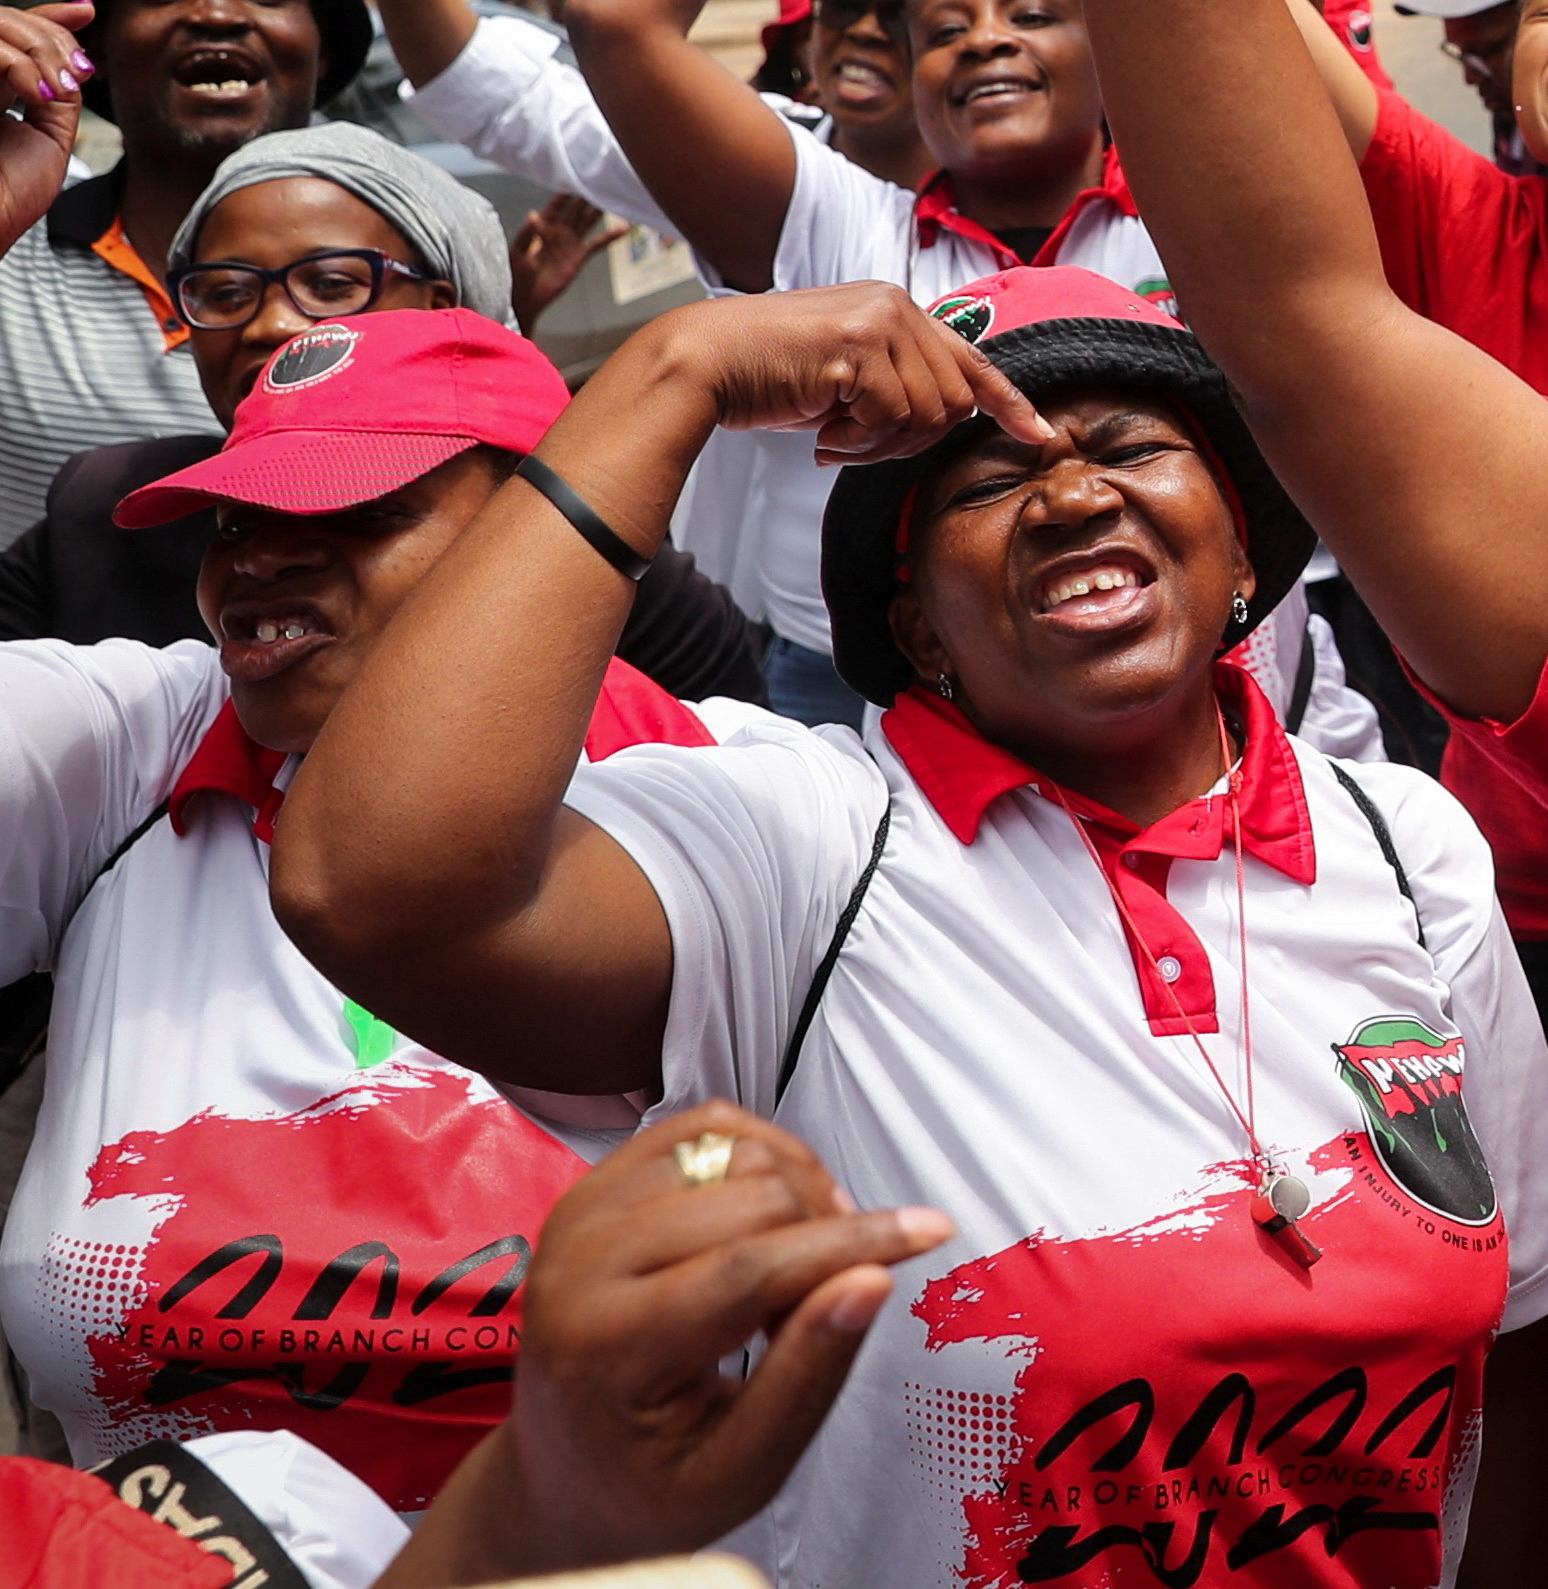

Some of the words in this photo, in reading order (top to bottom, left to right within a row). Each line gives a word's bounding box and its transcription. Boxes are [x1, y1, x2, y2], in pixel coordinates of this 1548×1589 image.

[1343, 1136, 1363, 1162] AN
[1358, 1165, 1411, 1217] INJURY
[1416, 1215, 1436, 1235] TO
[1442, 1229, 1469, 1251] ONE
[1472, 1237, 1484, 1253] IS
[114, 1322, 204, 1350] YEAR
[217, 1328, 266, 1353] OF
[279, 1328, 430, 1354] BRANCH
[993, 1477, 1082, 1511] YEAR
[1093, 1480, 1141, 1505] OF
[1153, 1468, 1271, 1510] BRANCH
[1277, 1464, 1441, 1492] CONGRESS
